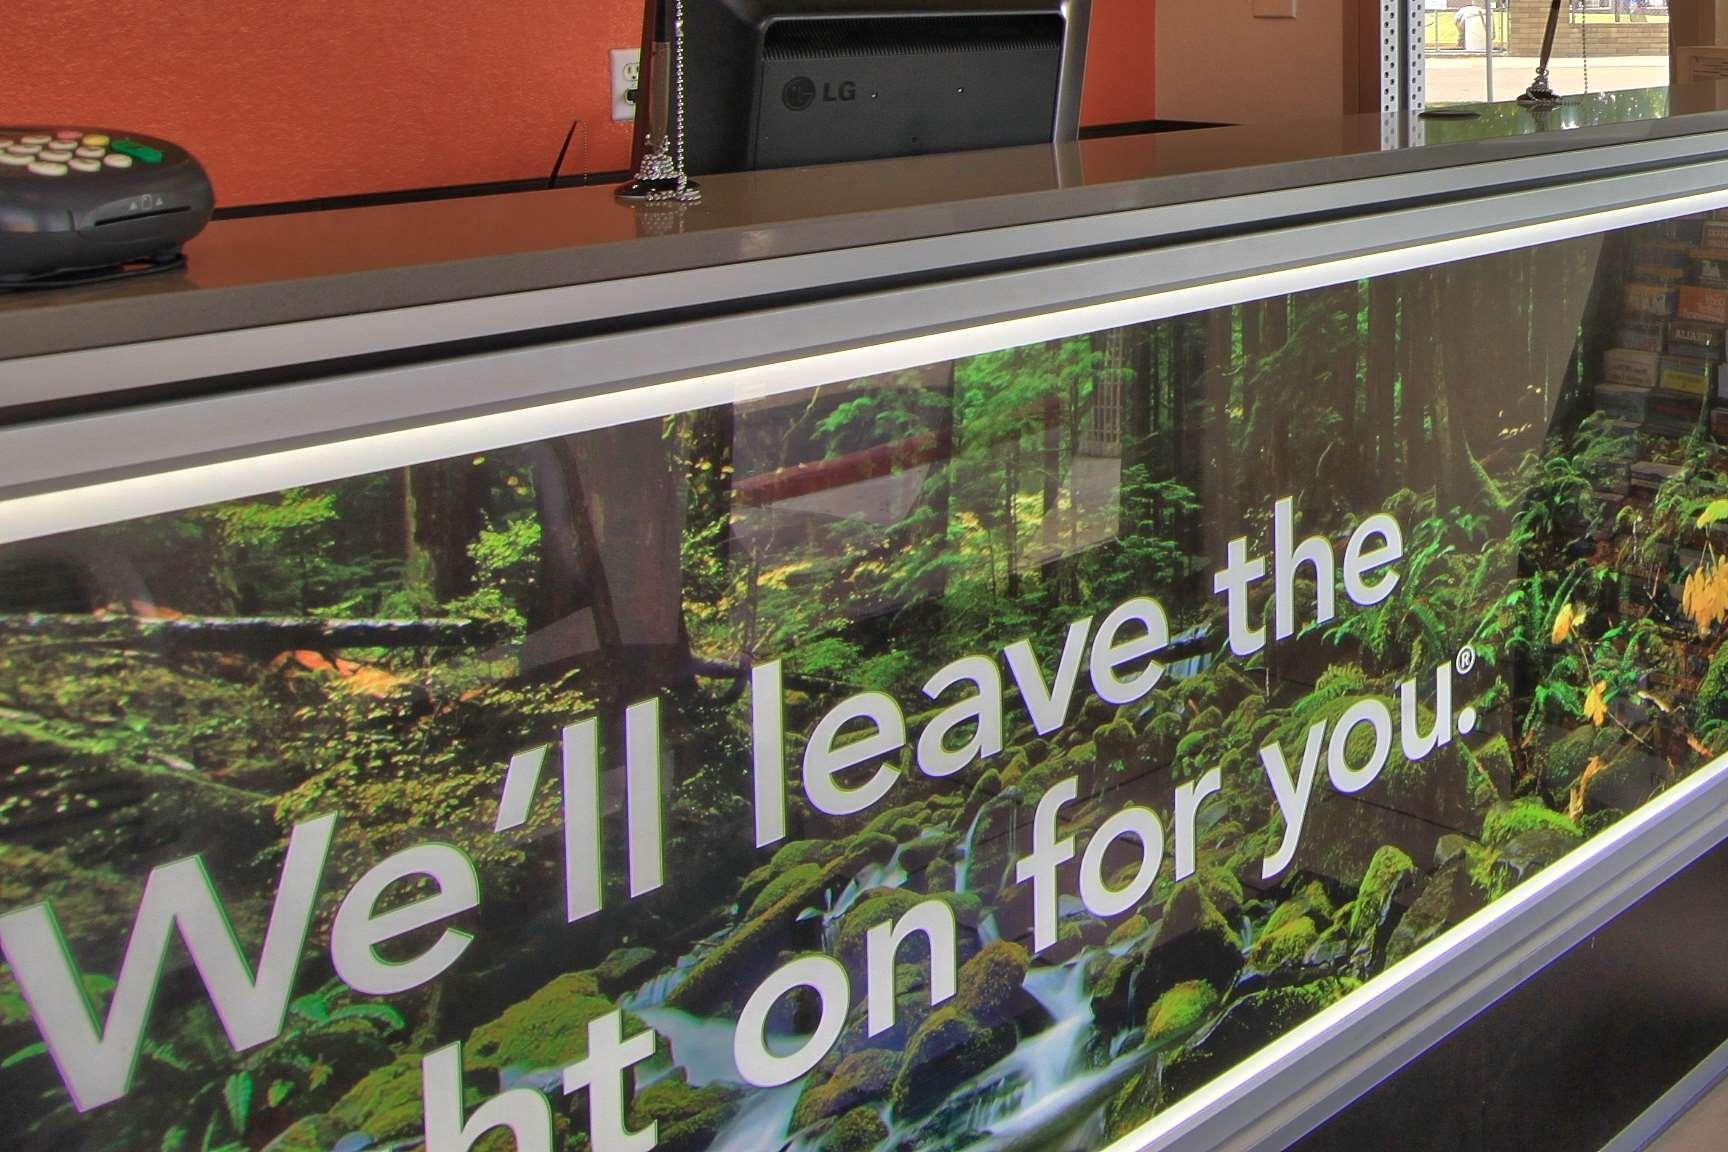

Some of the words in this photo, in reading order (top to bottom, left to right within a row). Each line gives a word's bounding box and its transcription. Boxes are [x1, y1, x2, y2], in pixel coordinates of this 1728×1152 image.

[823, 80, 857, 104] LG
[0, 696, 665, 1114] We'll
[750, 596, 1171, 849] leave
[1213, 495, 1404, 658] the
[733, 899, 957, 1090] on
[1016, 774, 1222, 956] for
